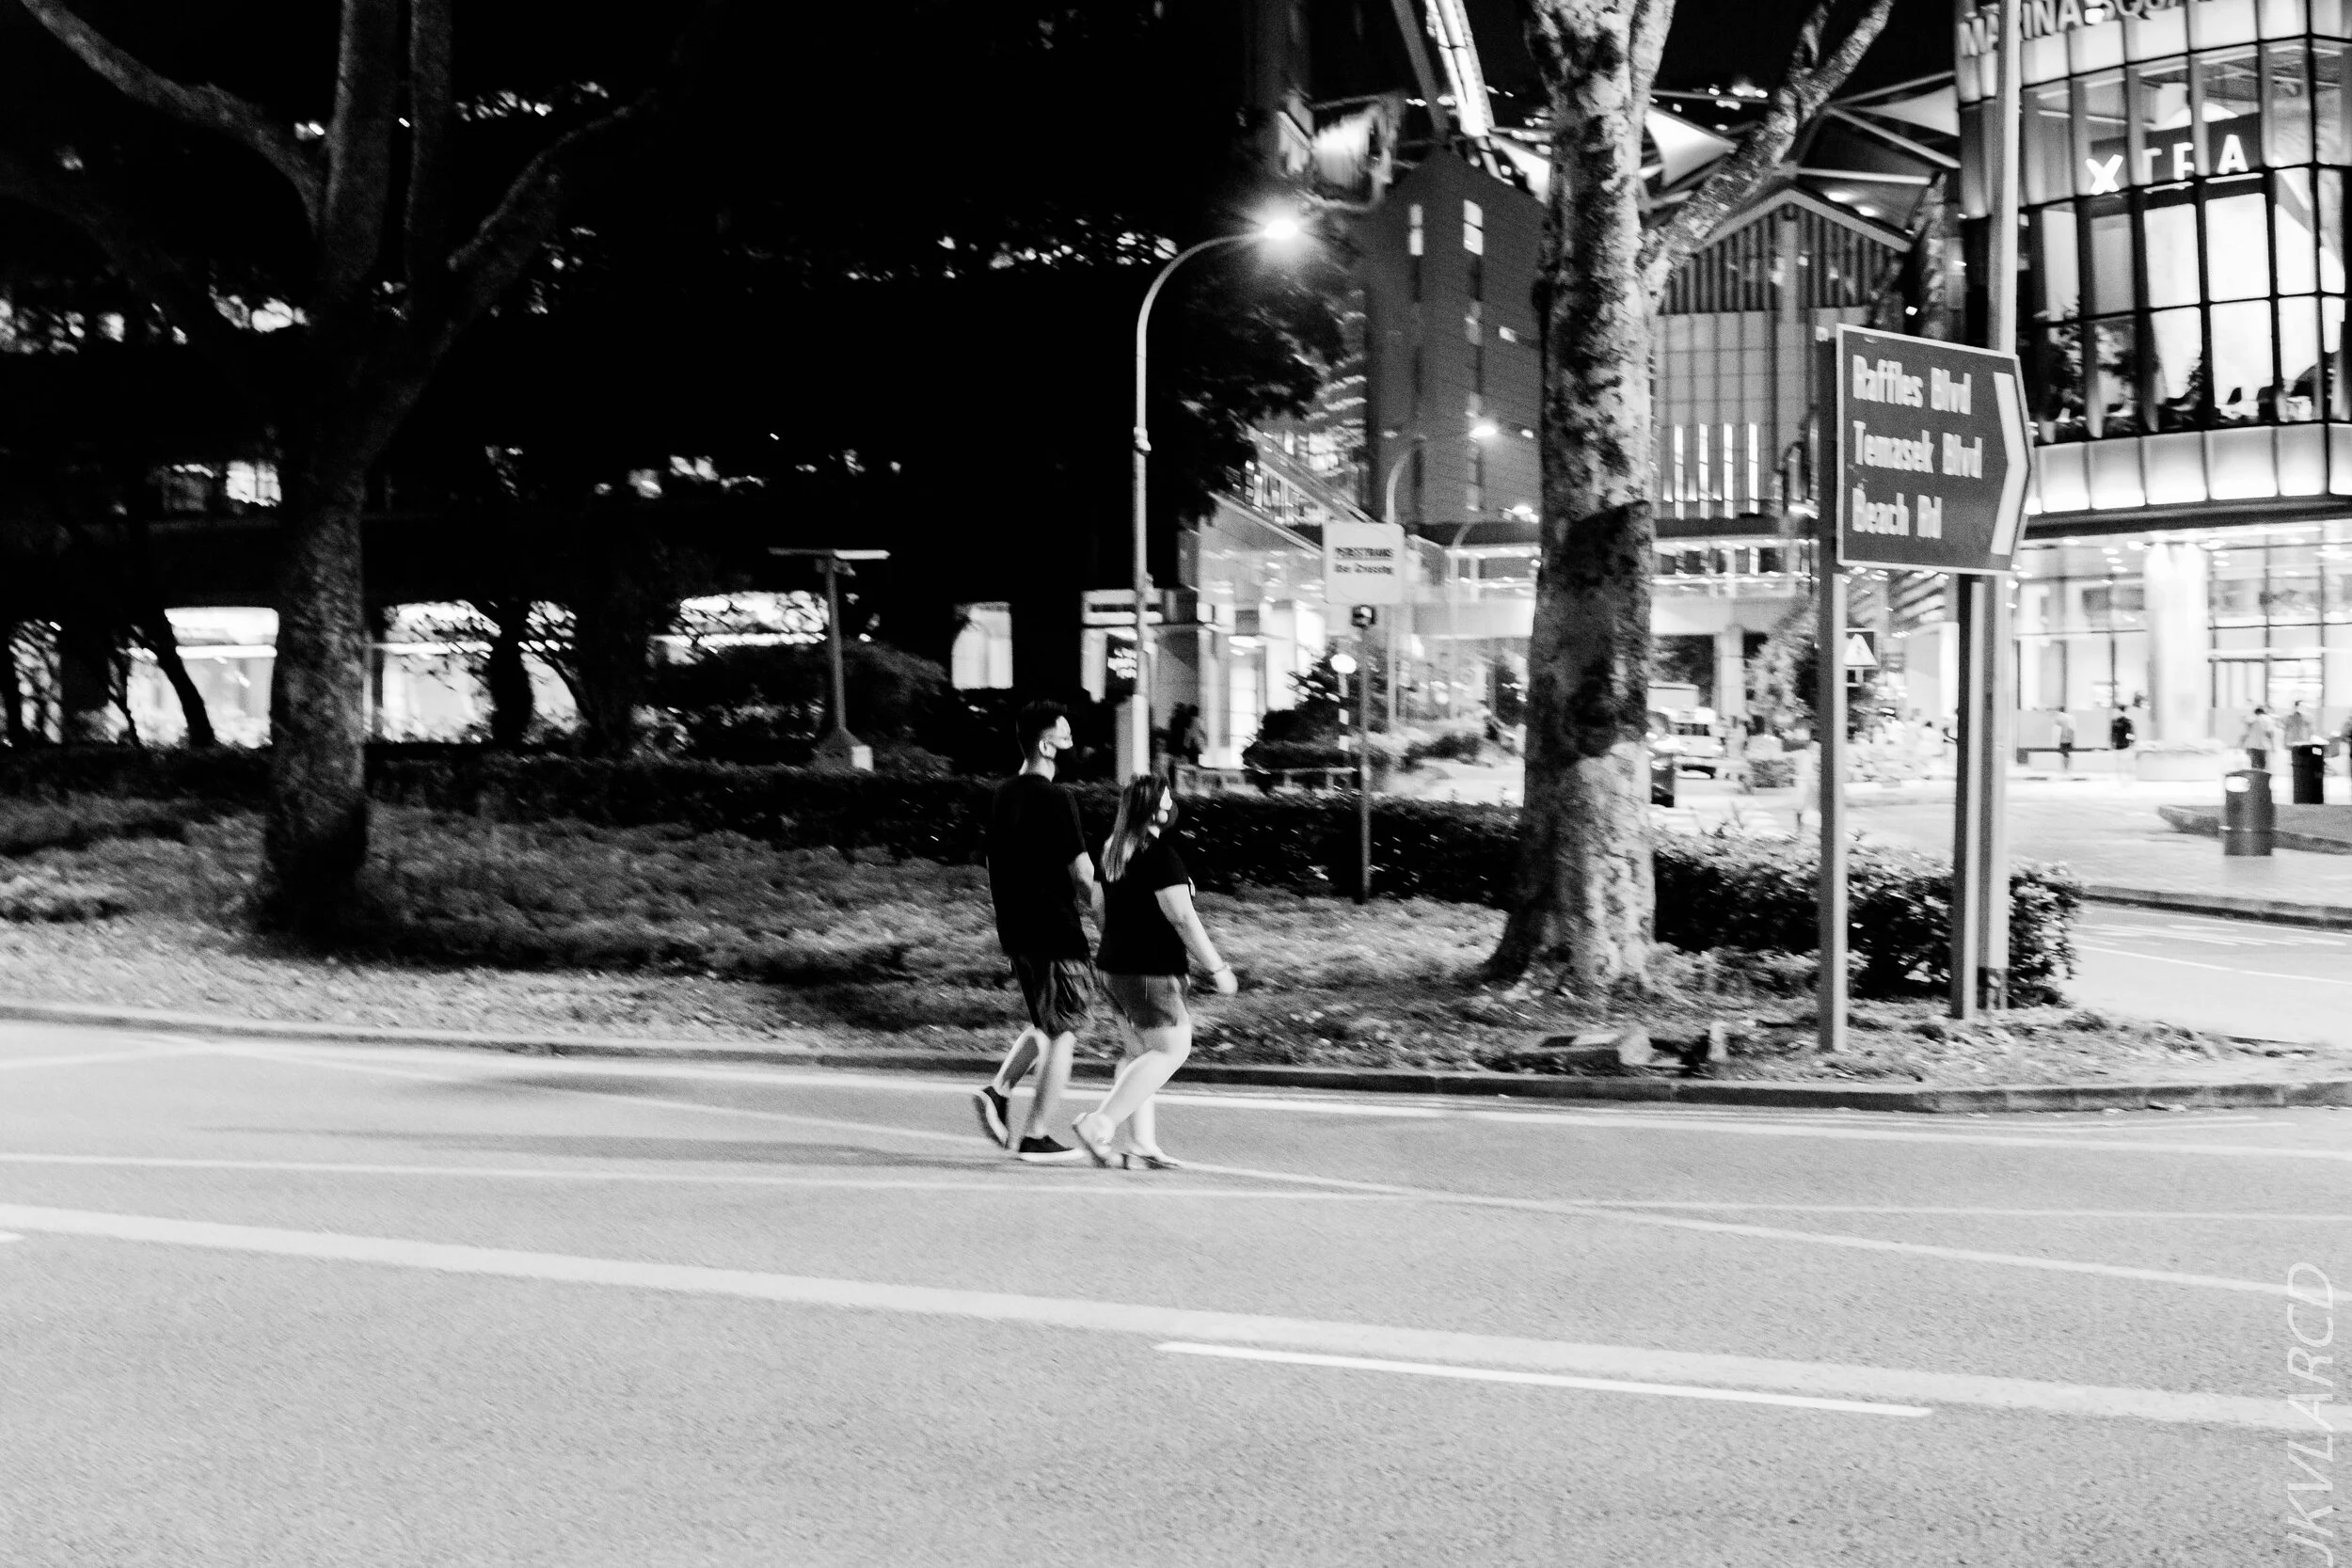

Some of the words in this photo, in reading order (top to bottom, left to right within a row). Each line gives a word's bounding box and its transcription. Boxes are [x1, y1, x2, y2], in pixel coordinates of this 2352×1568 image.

[1852, 354, 1924, 408] Raffles
[1931, 366, 1972, 415] Blvd
[1852, 420, 1934, 473] Temasek
[1942, 432, 1982, 479] Blvd
[1852, 487, 1910, 536] Beach
[1916, 494, 1942, 539] Rd
